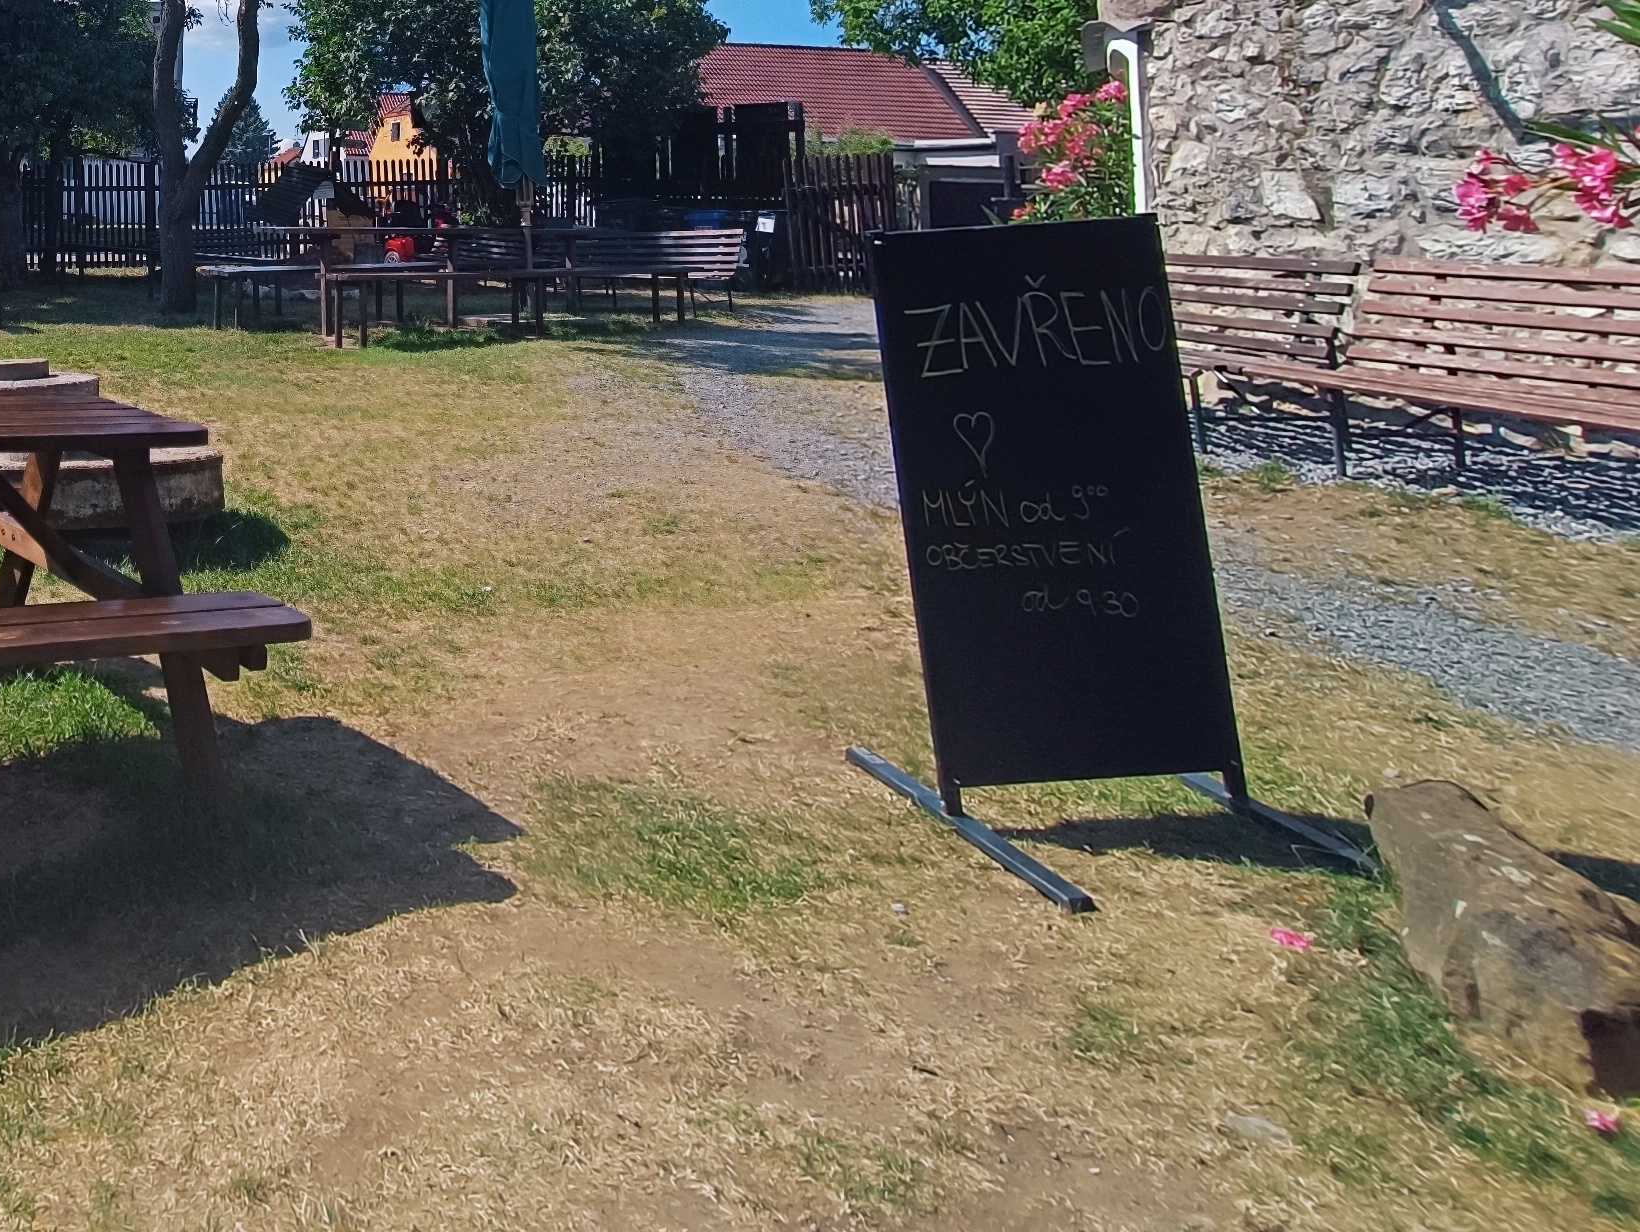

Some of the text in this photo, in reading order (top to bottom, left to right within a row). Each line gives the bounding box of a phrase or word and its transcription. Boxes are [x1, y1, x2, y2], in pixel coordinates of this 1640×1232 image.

[904, 274, 1167, 378] ZAVŘENO
[922, 479, 1009, 528] MLÝN
[1020, 492, 1067, 523] od
[926, 527, 1130, 570] OBČERSTVENÍ
[1021, 584, 1069, 612] od
